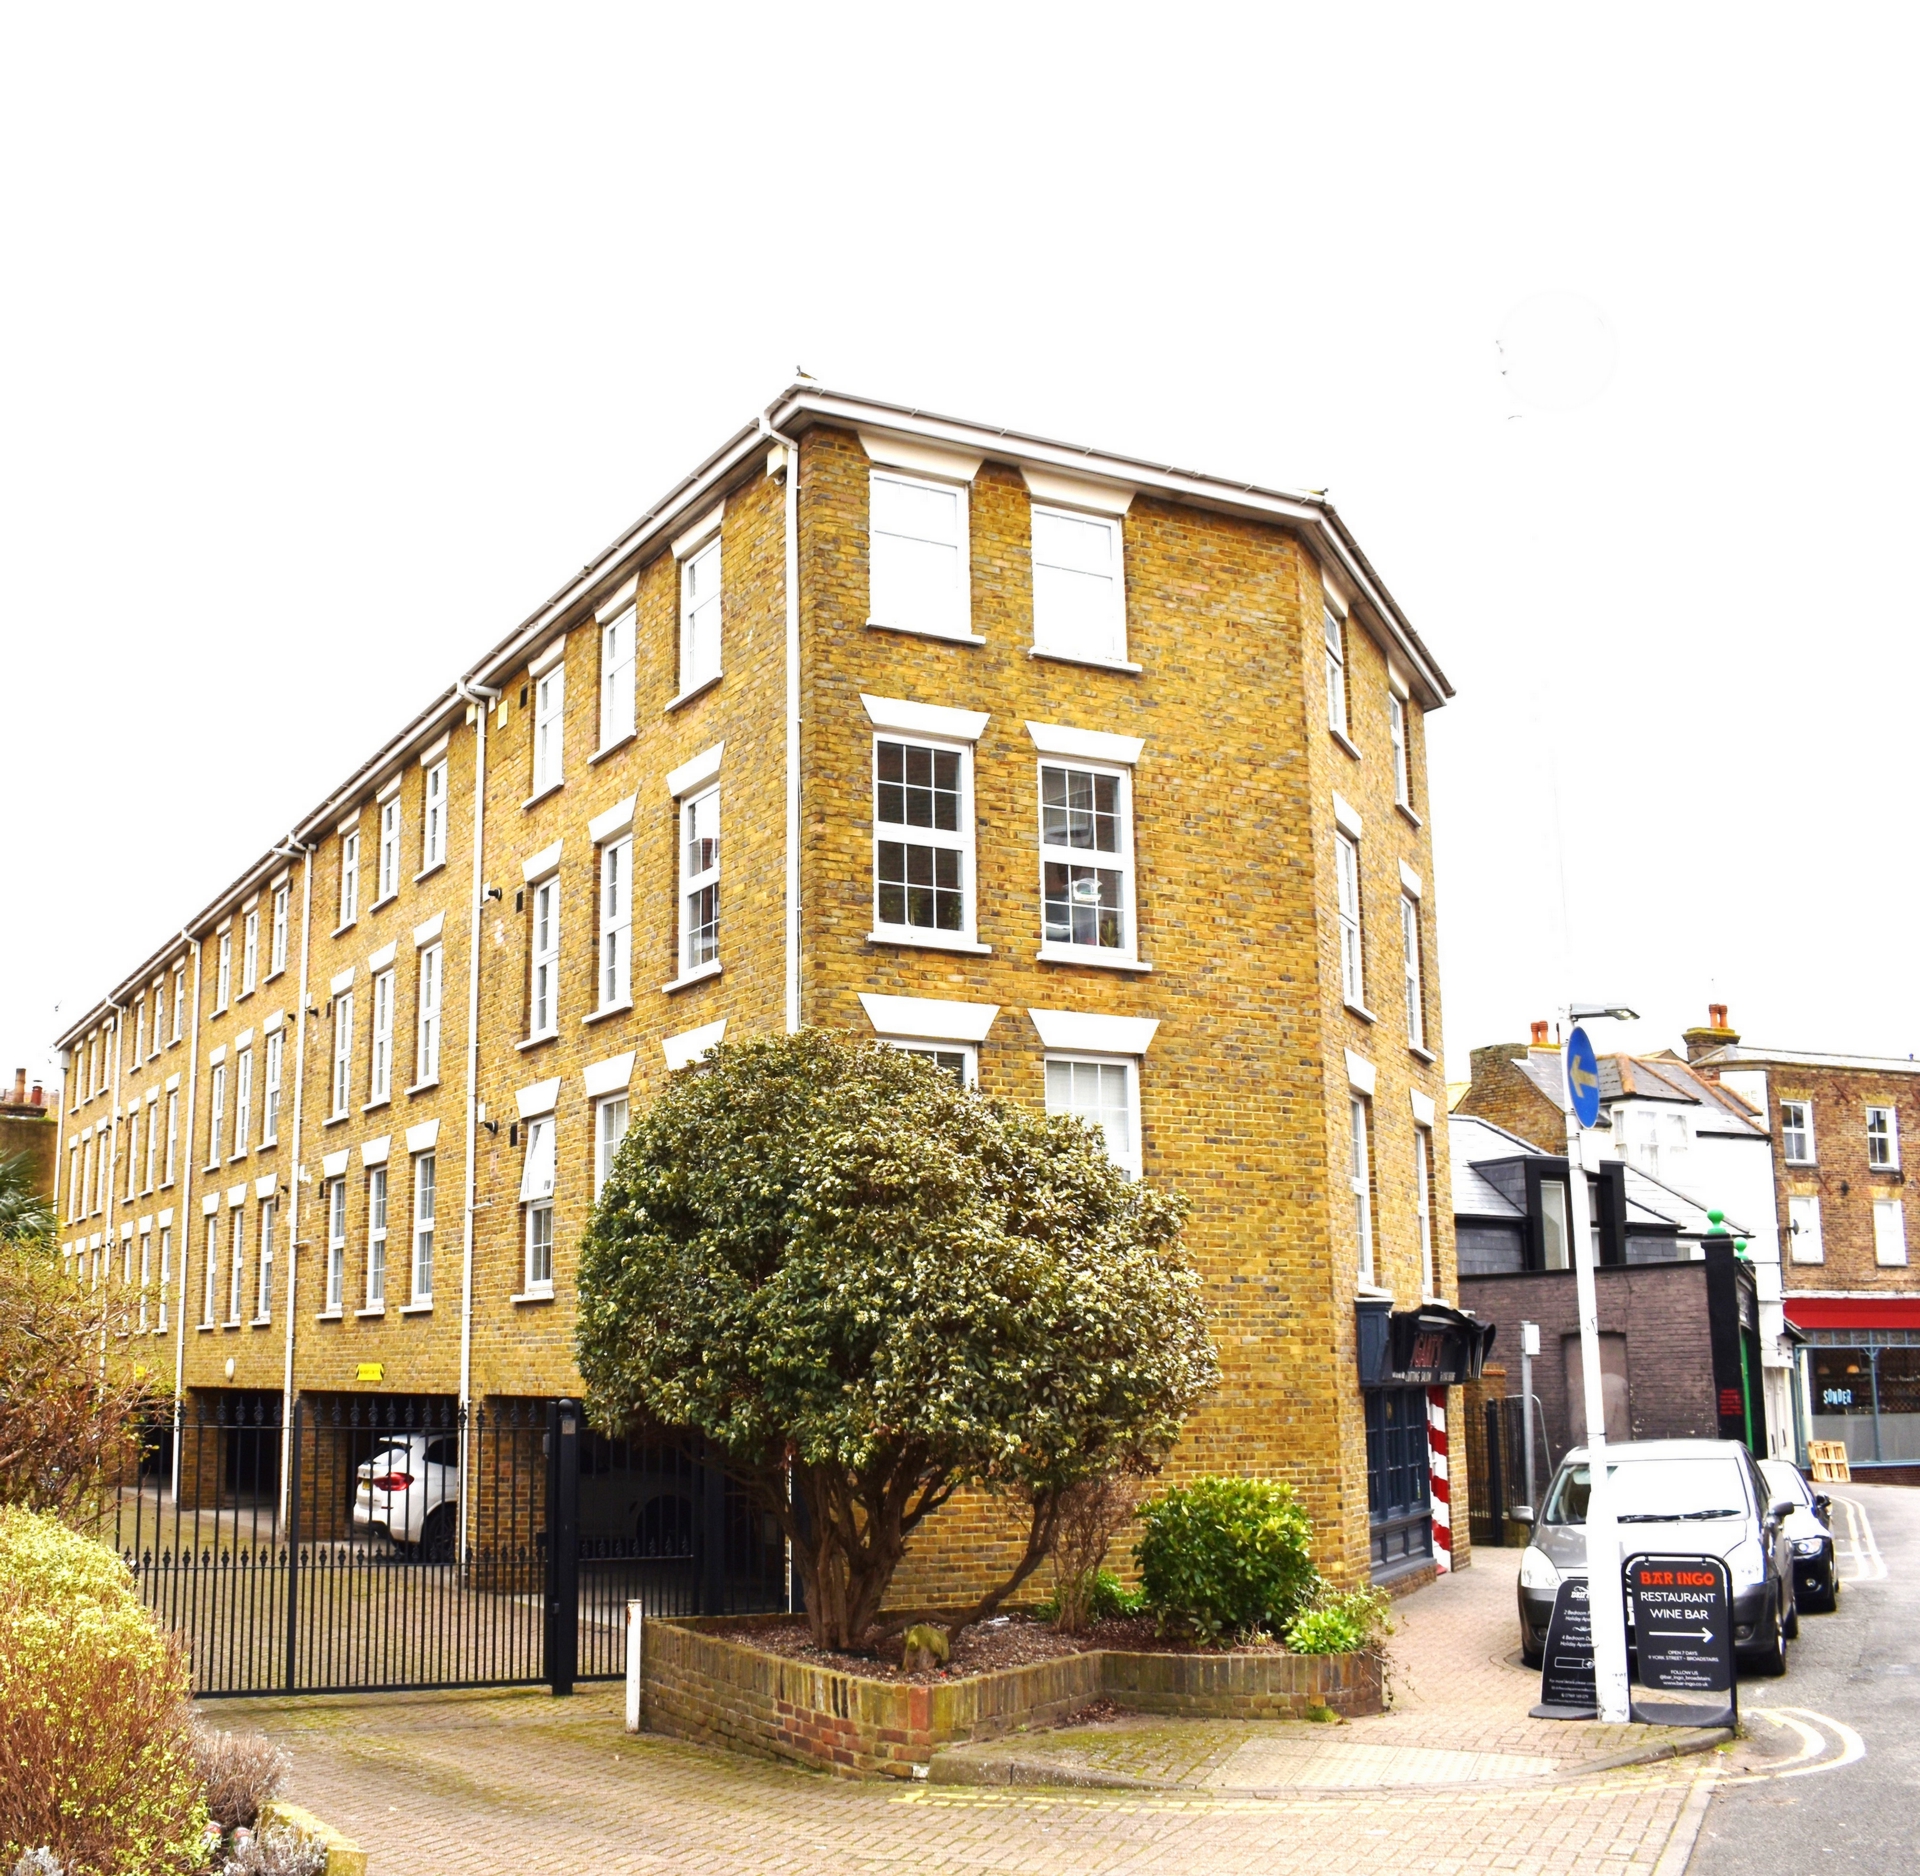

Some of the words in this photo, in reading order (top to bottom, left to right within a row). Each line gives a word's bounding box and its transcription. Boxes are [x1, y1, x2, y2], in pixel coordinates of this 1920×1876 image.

[1640, 1571, 1674, 1585] BAR
[1676, 1571, 1715, 1586] INGO
[1640, 1591, 1716, 1603] RESTAURANT
[1649, 1608, 1683, 1619] WINE
[1684, 1609, 1709, 1620] BAR
